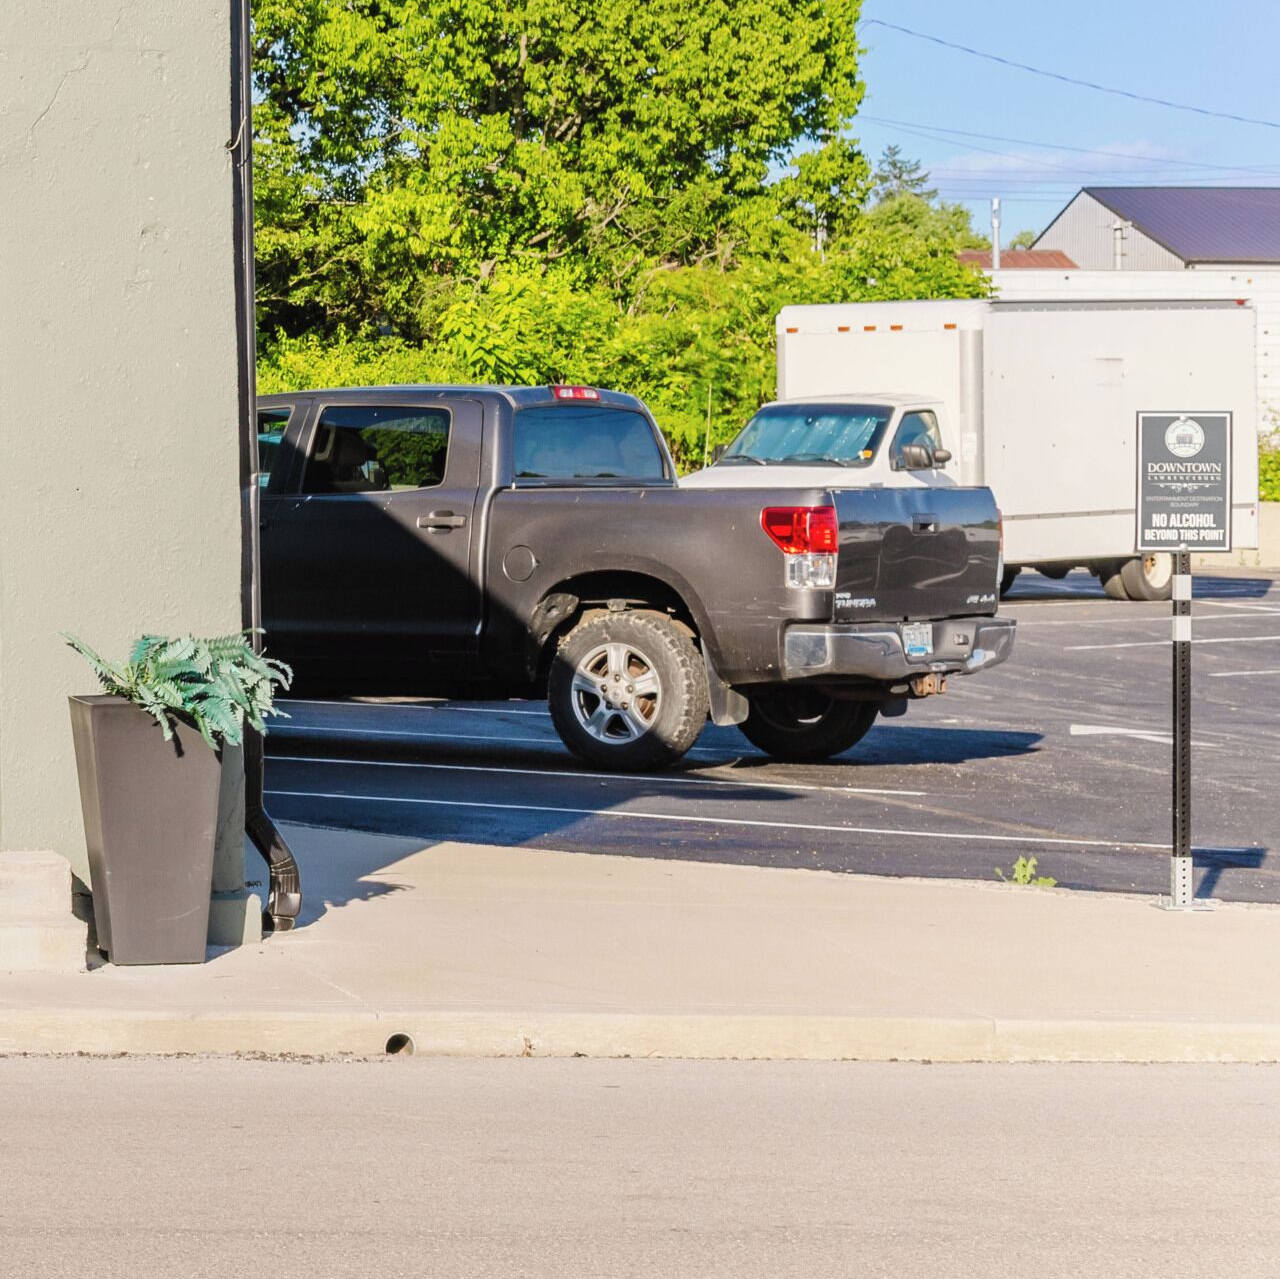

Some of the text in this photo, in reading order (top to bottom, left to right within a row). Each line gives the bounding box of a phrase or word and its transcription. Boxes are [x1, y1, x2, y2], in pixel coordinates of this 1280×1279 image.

[1147, 463, 1222, 473] DOWNTOWN
[1152, 513, 1217, 528] NO ALCOHOL
[1144, 529, 1225, 541] BEYOND THIS POINT
